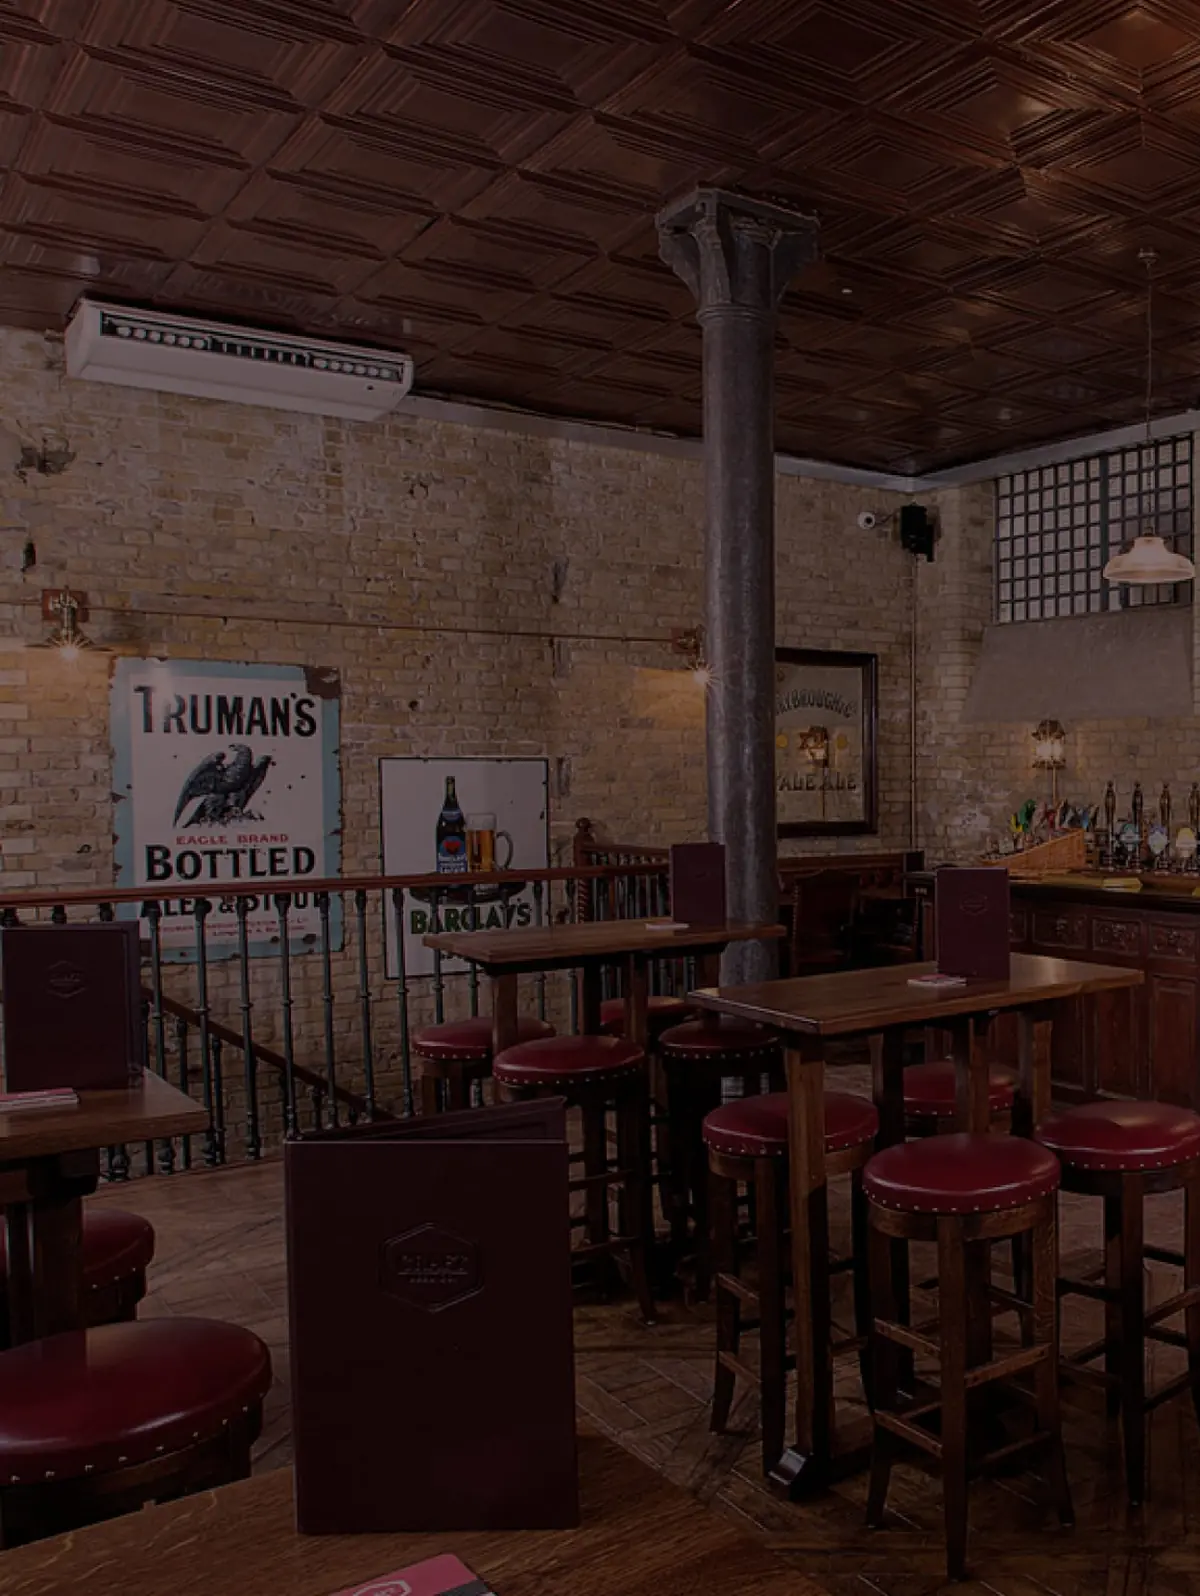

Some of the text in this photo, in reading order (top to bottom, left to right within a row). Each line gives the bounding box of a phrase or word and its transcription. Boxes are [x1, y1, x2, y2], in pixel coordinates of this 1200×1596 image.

[134, 685, 316, 737] TRUMAN'S
[176, 833, 289, 845] EAGLE BRAND
[146, 844, 315, 881] BOTTLED
